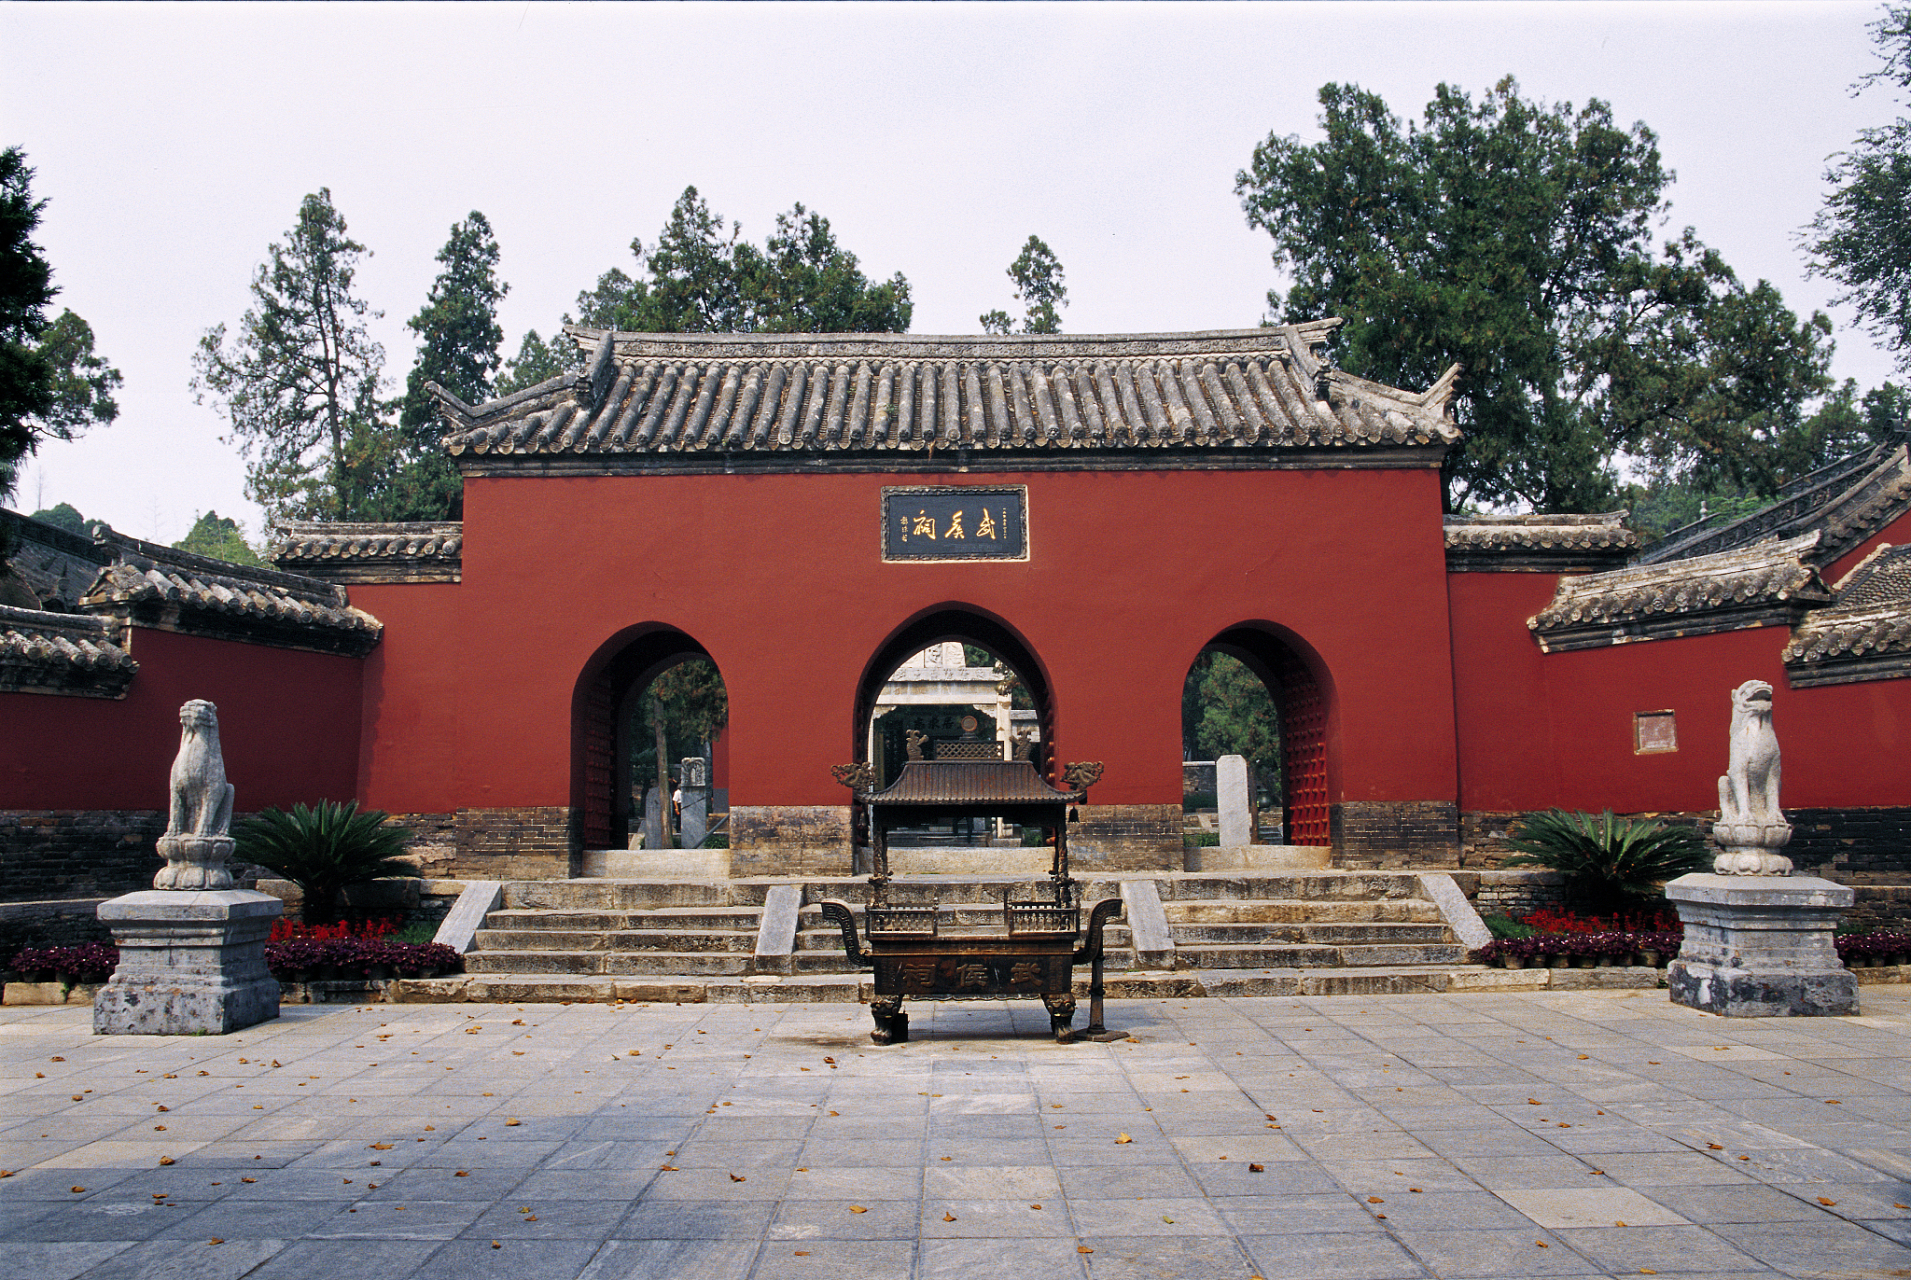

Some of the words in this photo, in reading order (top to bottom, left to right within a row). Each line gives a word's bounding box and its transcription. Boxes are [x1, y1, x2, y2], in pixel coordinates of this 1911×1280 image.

[912, 507, 996, 541] 武侯祠
[902, 962, 1044, 988] 武侯祠
